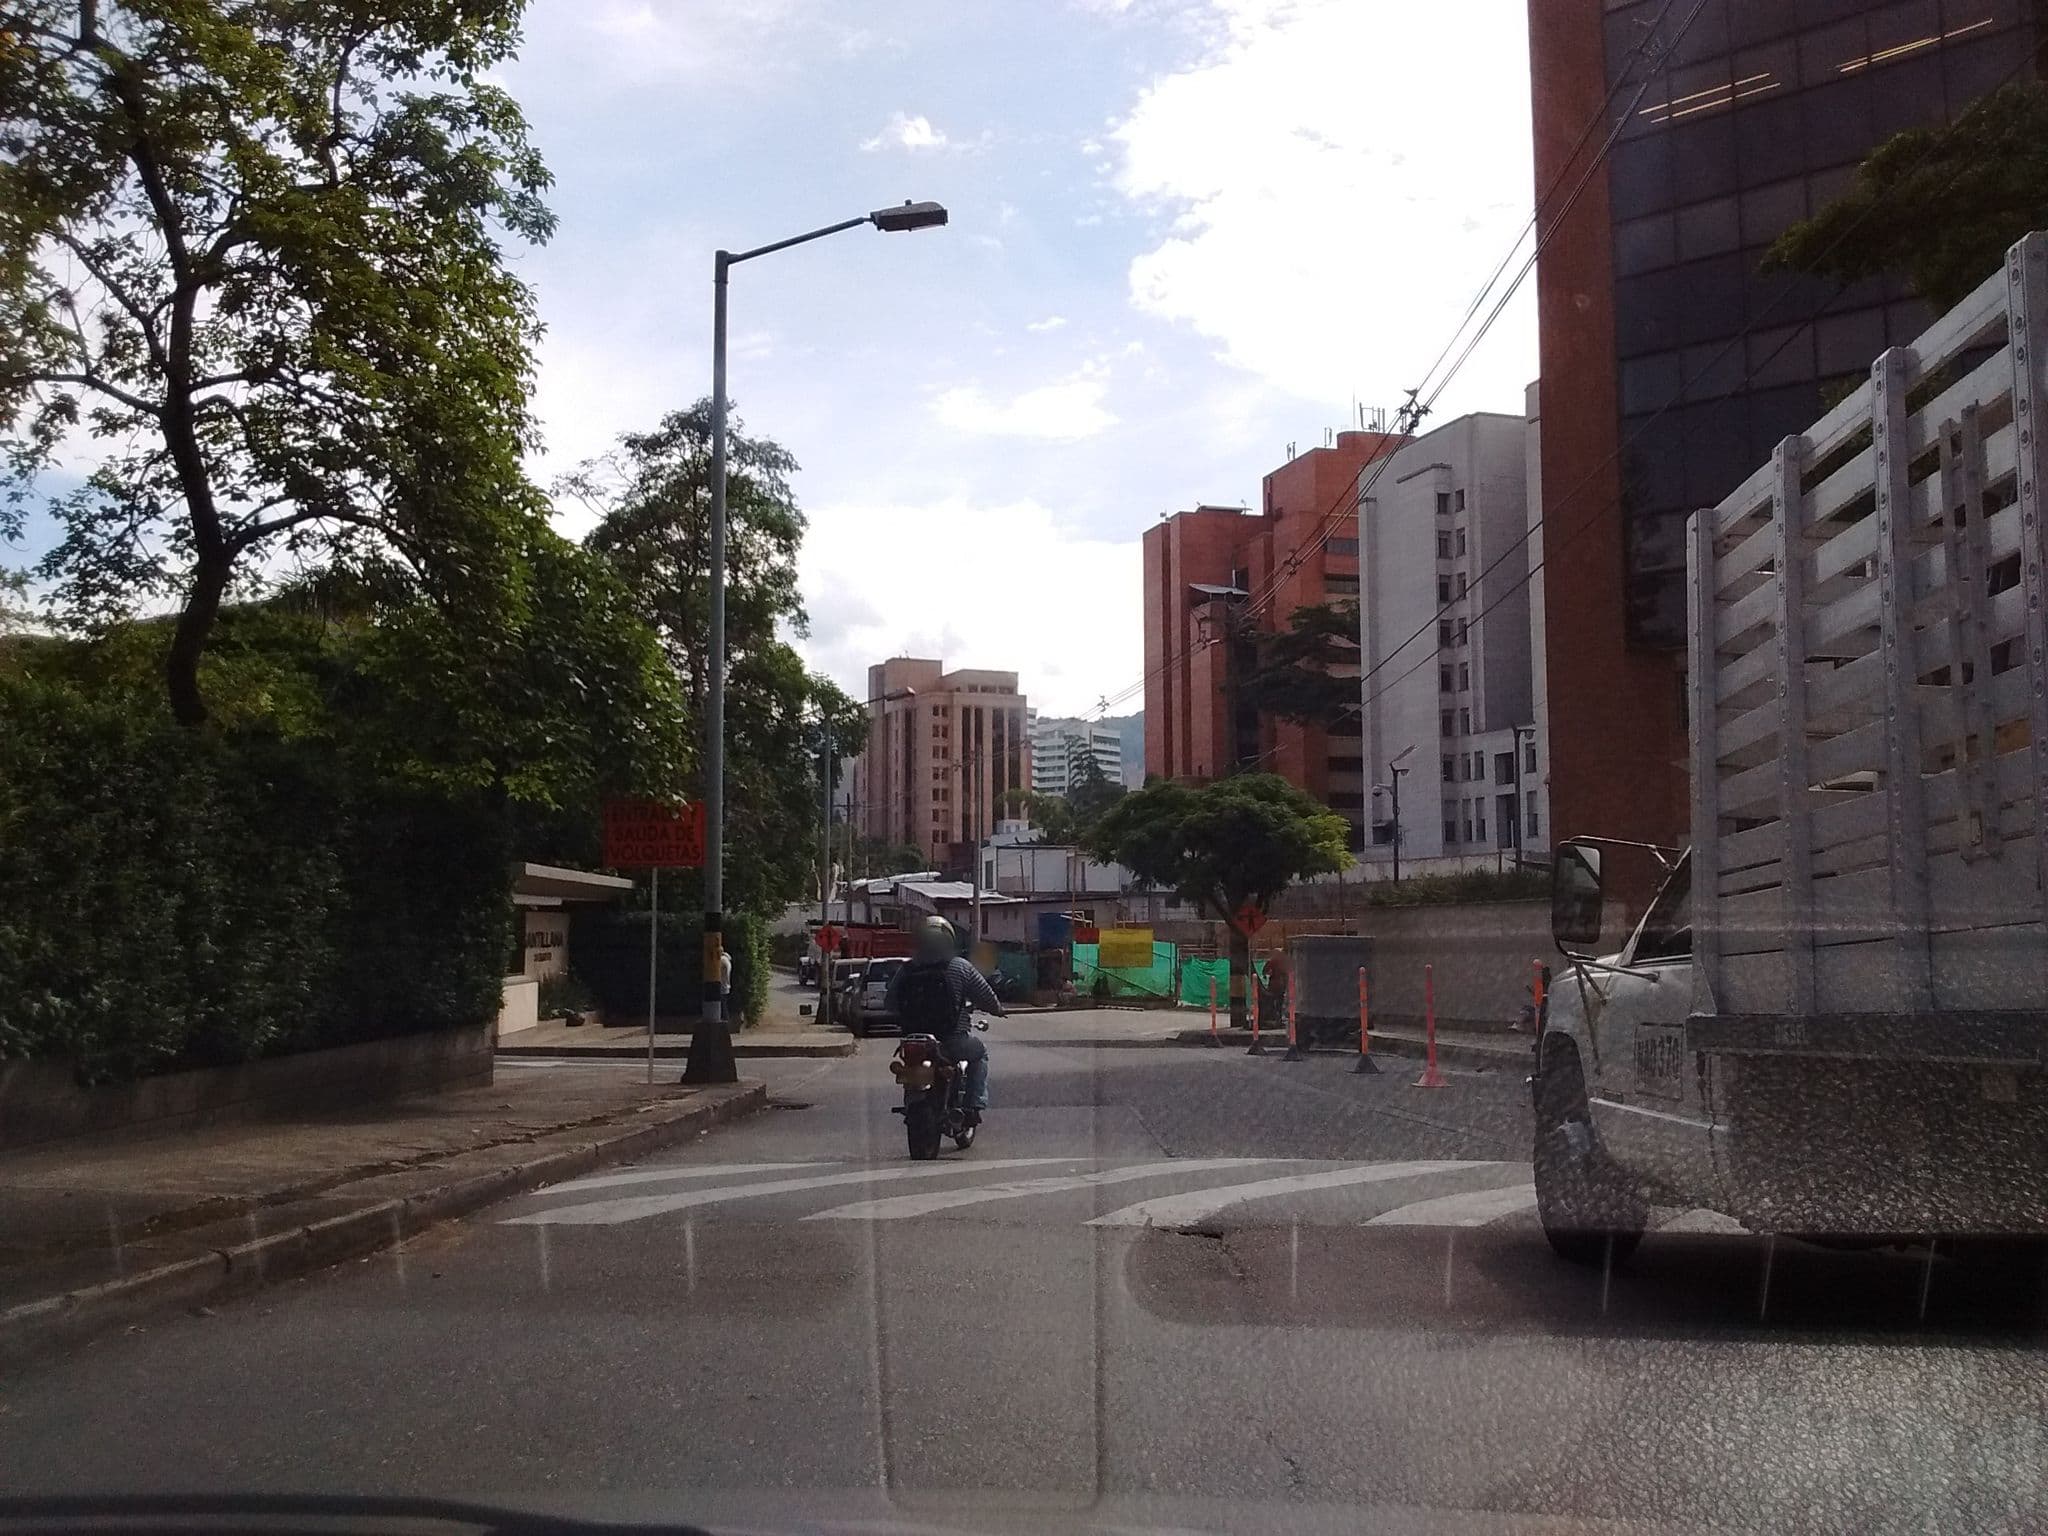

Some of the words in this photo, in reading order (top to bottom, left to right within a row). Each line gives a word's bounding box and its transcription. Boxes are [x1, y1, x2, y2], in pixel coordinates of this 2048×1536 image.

[614, 824, 672, 842] SALIDA
[675, 825, 695, 842] DE
[609, 843, 701, 862] VOLQUETAS
